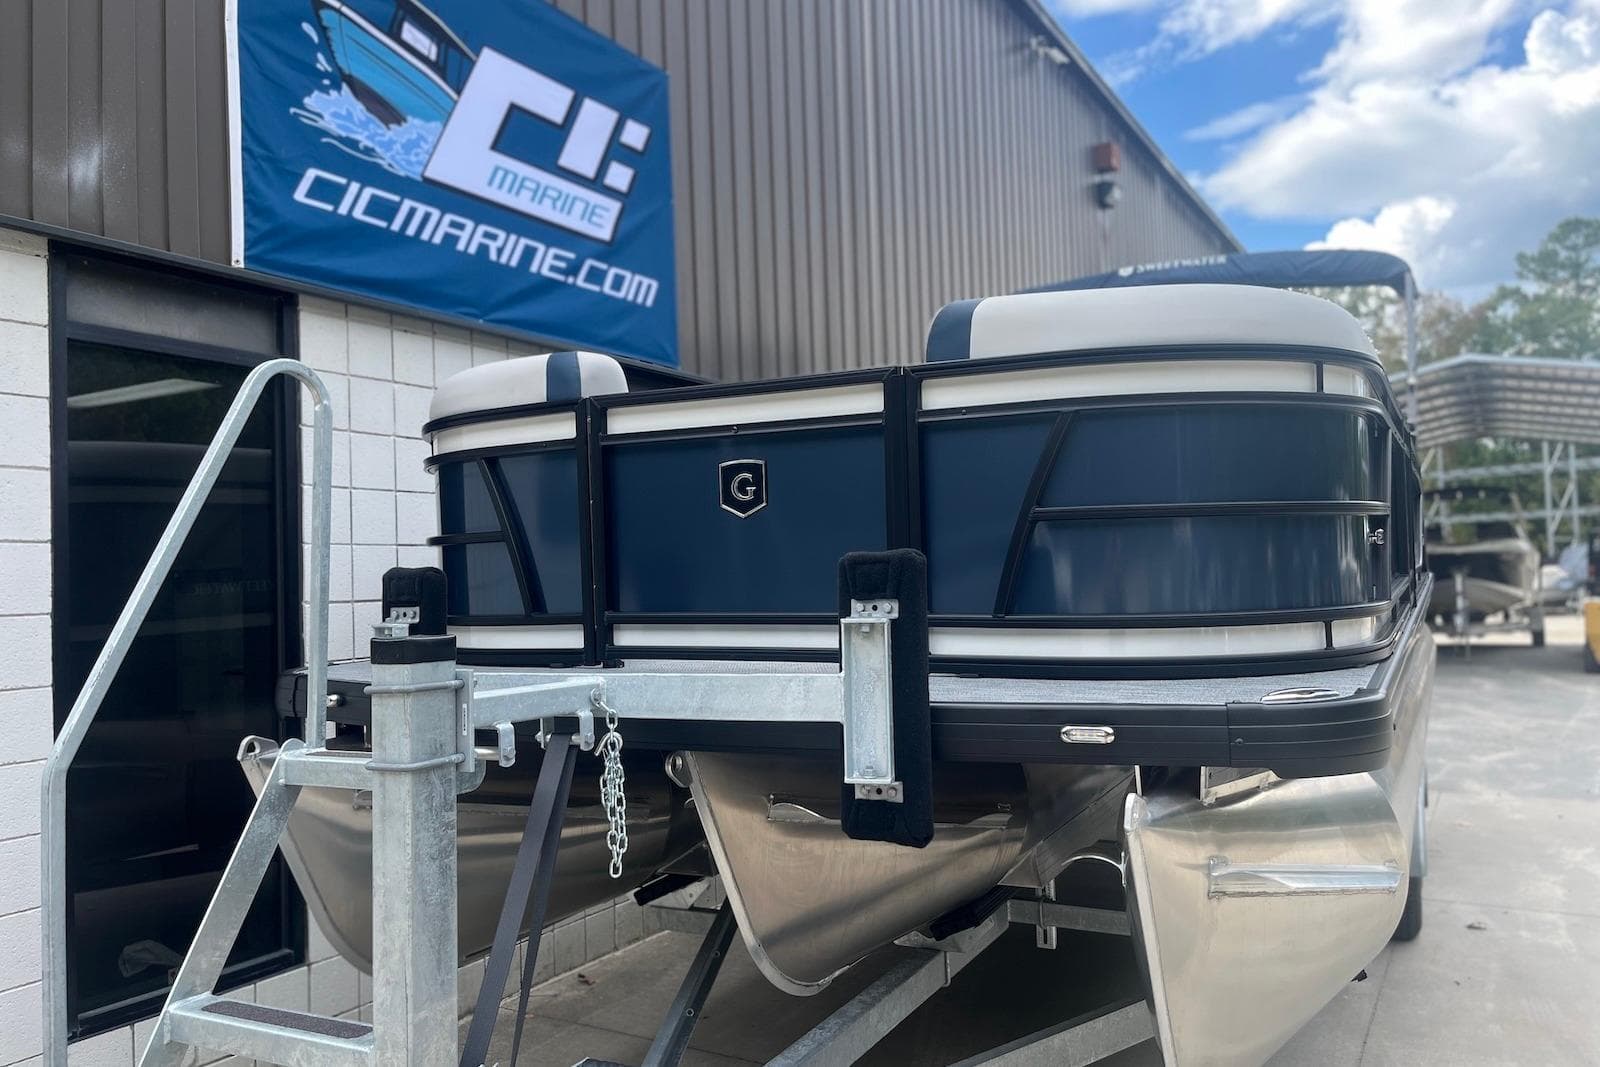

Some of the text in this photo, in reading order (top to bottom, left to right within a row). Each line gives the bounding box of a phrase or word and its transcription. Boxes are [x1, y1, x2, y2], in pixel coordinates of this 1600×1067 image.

[487, 164, 611, 229] MARINE
[292, 167, 659, 308] CICMARINE.COM
[730, 472, 757, 501] G
